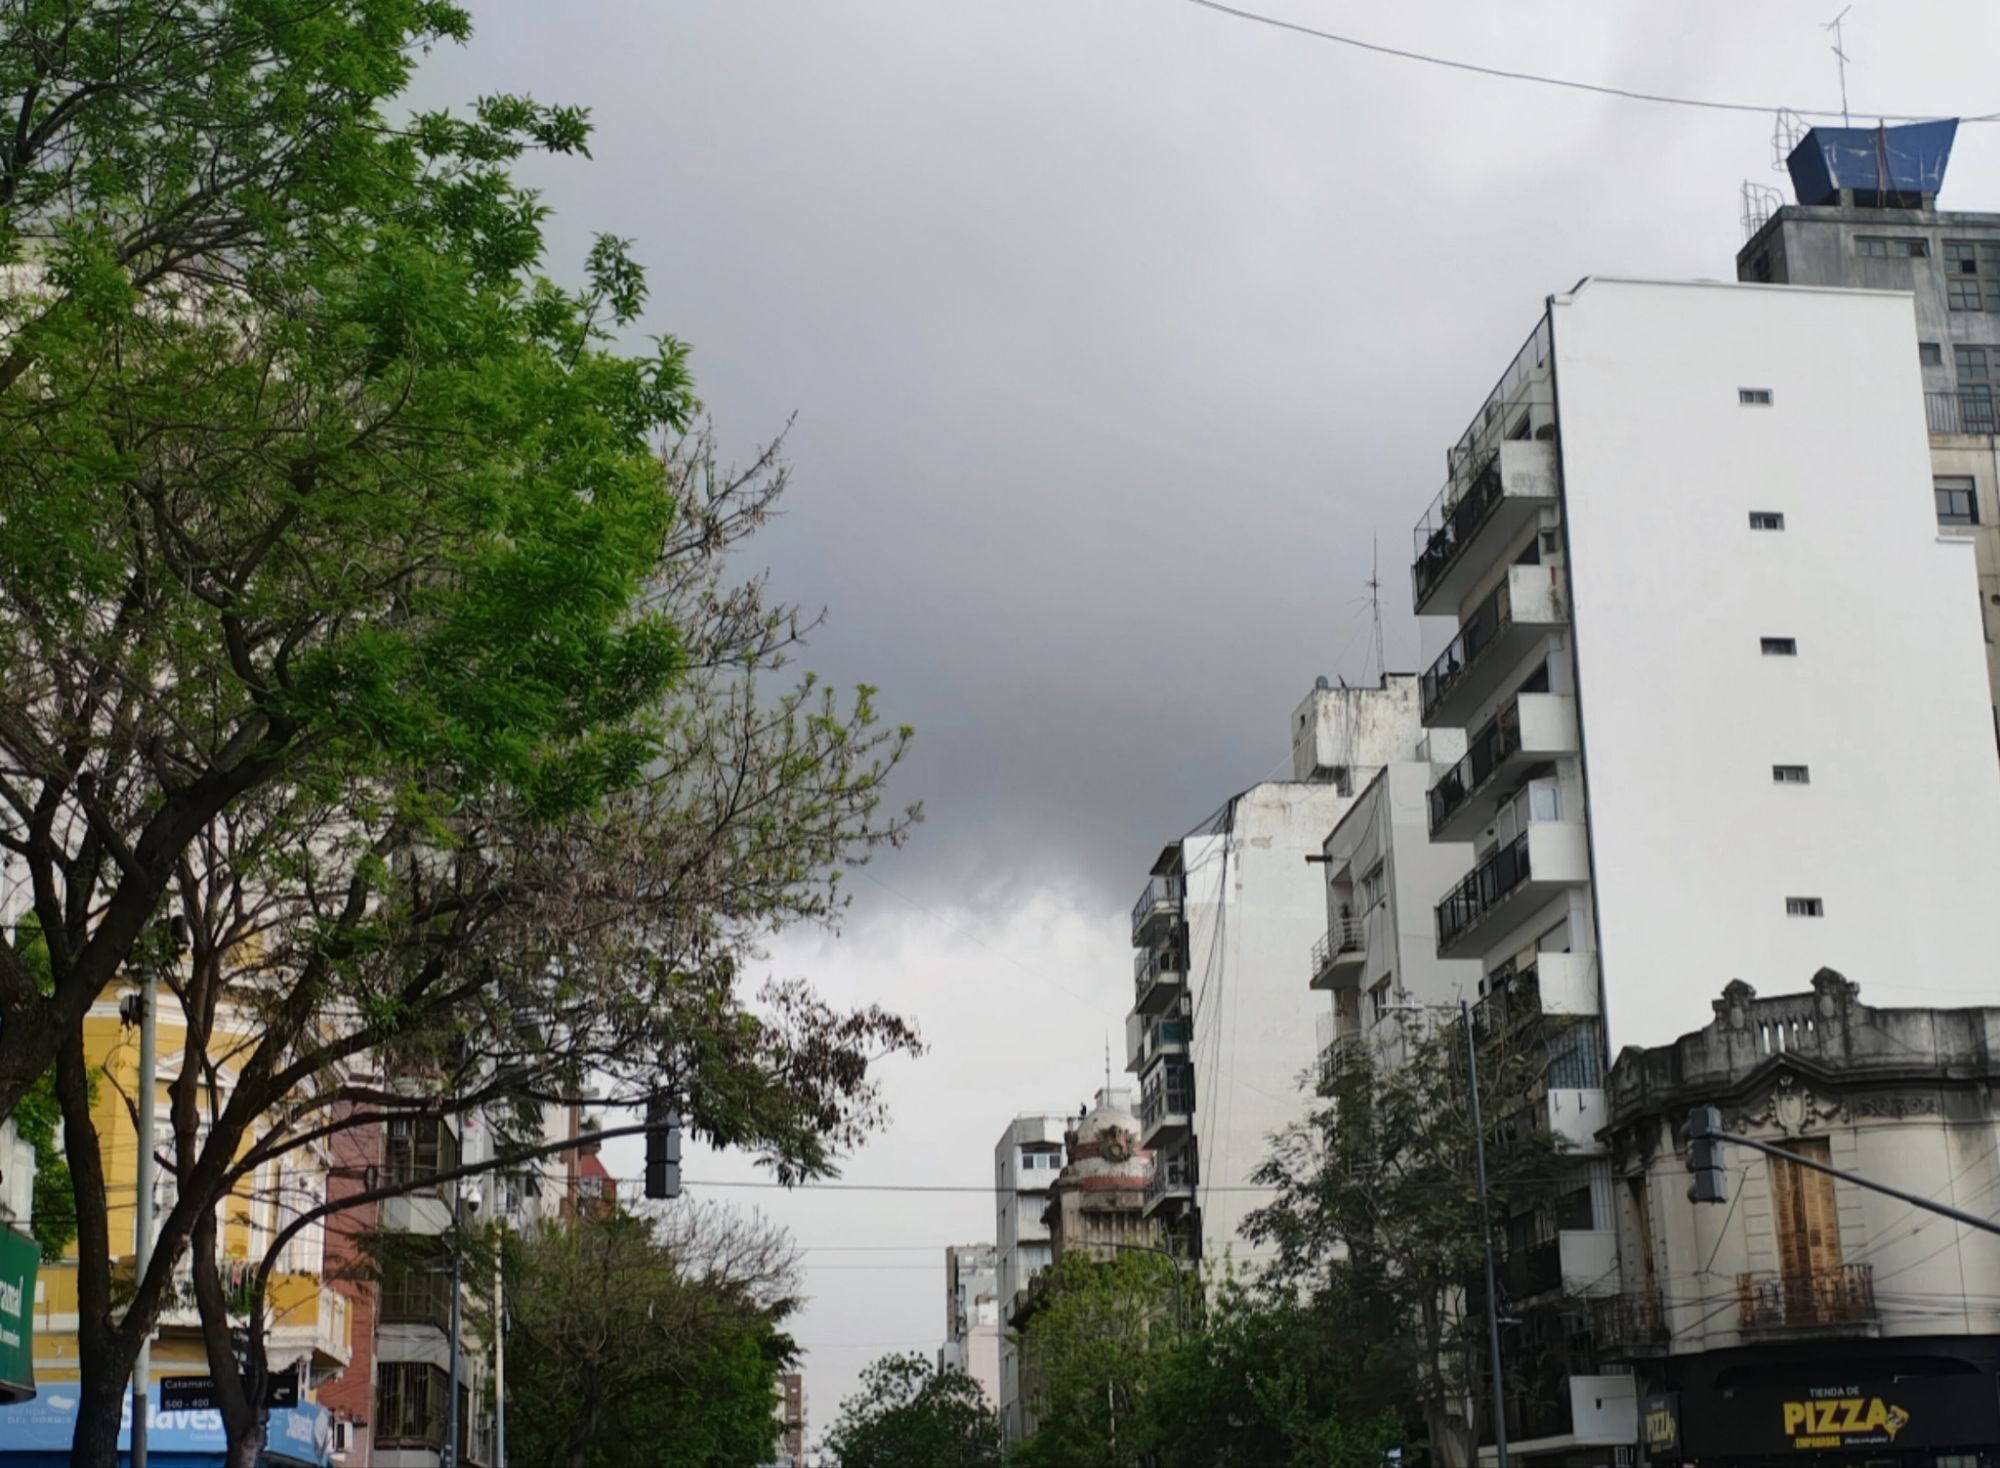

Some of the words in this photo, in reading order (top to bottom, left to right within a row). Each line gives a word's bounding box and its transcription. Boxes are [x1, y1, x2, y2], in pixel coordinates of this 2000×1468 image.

[1809, 1386, 1845, 1398] TIENDA
[1846, 1385, 1860, 1396] DE
[1783, 1397, 1888, 1435] PIZZA
